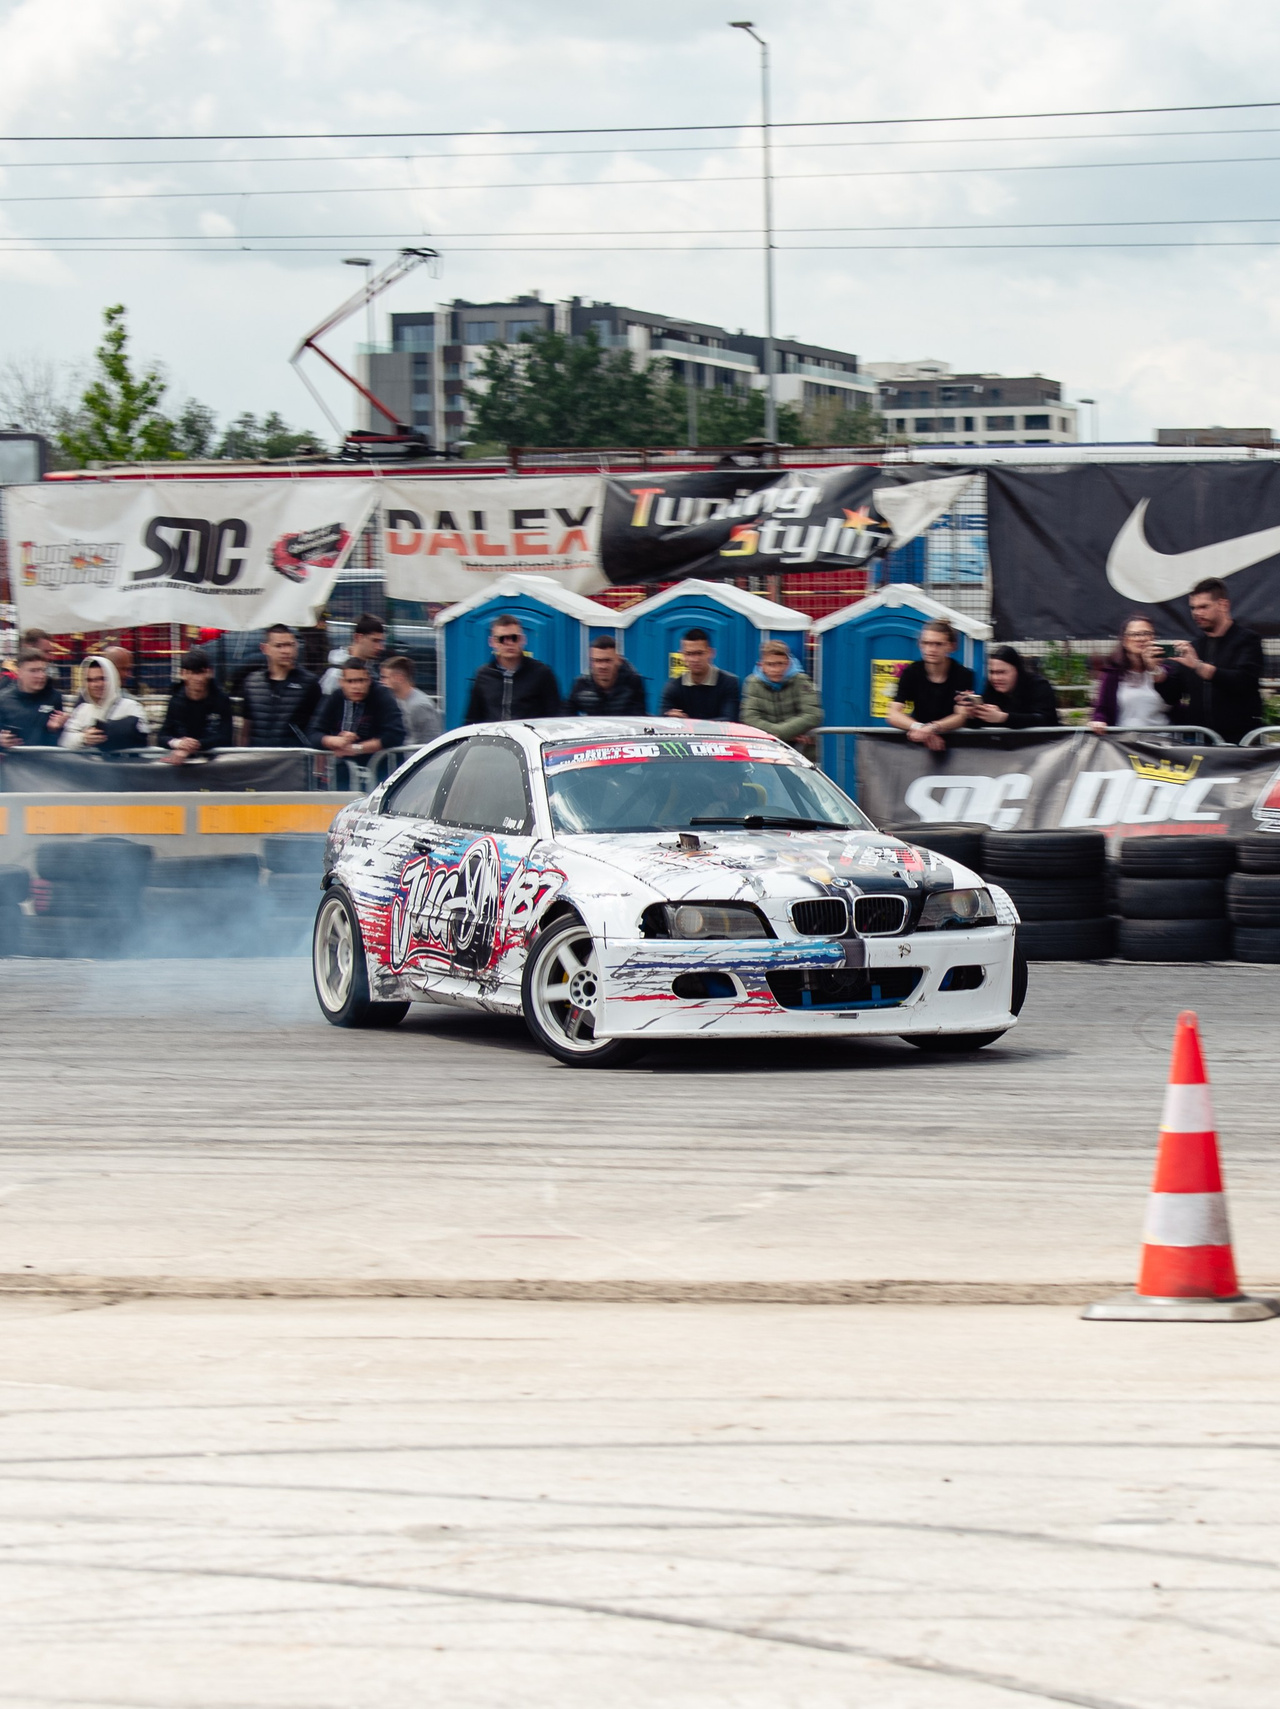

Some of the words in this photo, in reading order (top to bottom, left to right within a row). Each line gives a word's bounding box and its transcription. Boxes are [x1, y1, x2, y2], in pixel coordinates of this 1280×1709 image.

[384, 506, 593, 556] DALEX
[630, 486, 823, 527] Tuning
[133, 516, 249, 586] SDC
